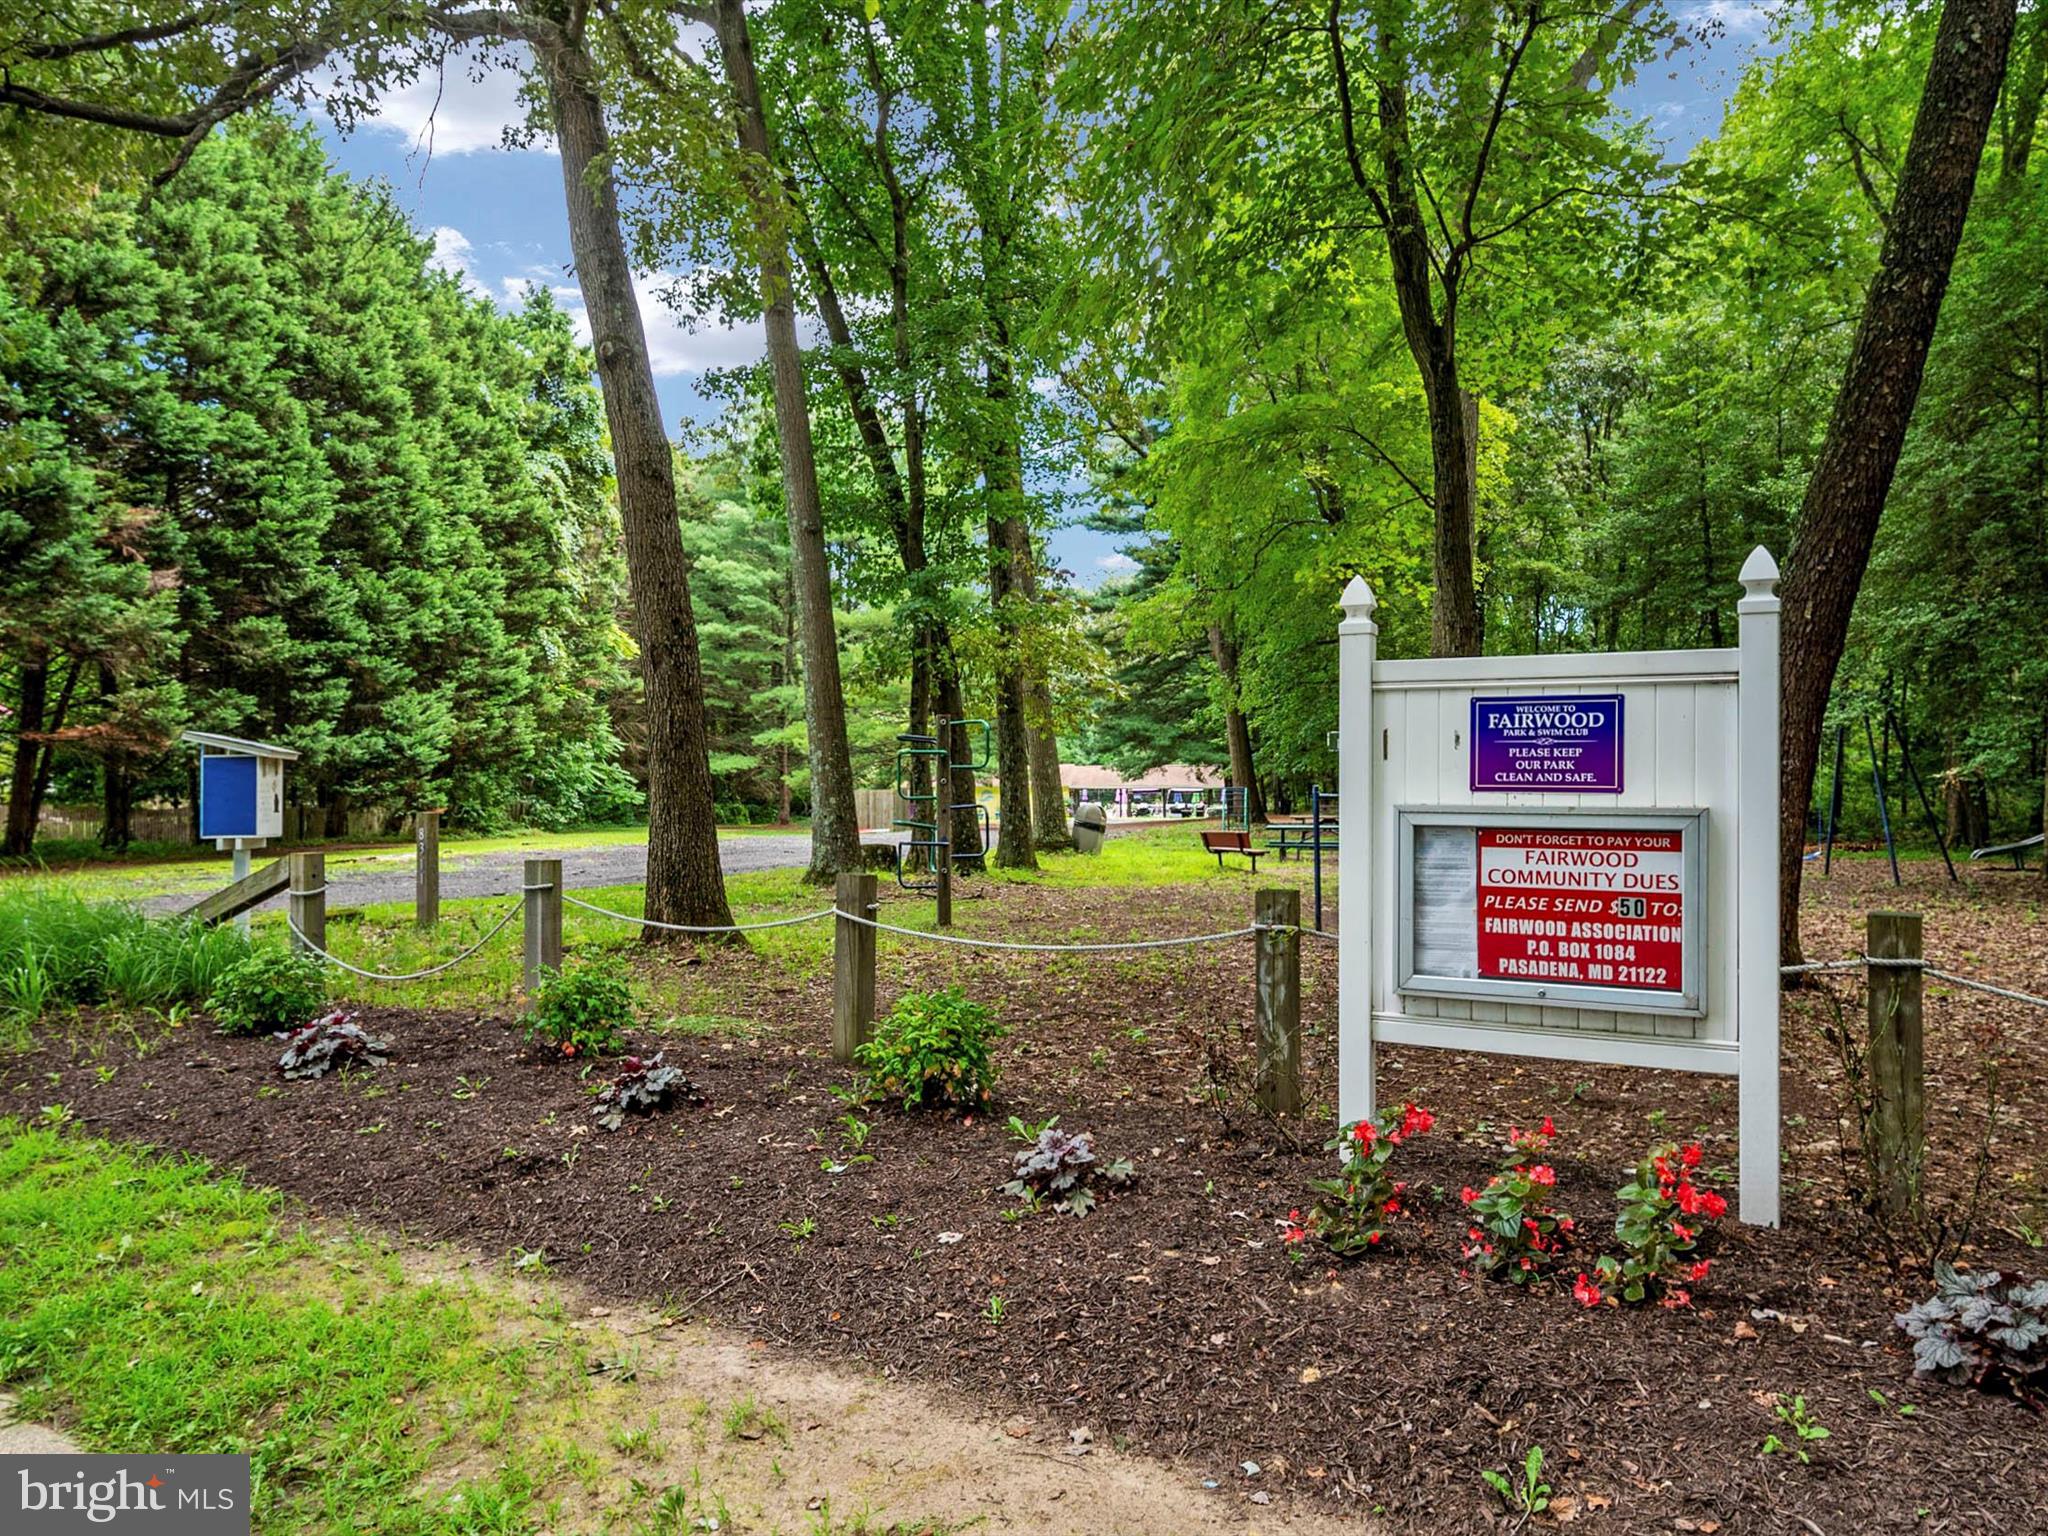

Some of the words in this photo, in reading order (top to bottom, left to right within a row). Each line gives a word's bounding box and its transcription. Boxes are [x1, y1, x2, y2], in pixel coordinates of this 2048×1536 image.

[1516, 705, 1561, 713] WELCOME
[1563, 704, 1576, 712] TO
[1488, 712, 1605, 729] FAIRWOOD
[1503, 729, 1527, 737] PARK
[1537, 728, 1563, 736] SWIM
[1564, 728, 1589, 736] CLUB
[1509, 748, 1551, 757] PLEASE
[1553, 748, 1583, 757] KEEP
[1515, 760, 1541, 770] OUR
[1543, 760, 1575, 769] PARK
[1495, 772, 1533, 782] CLEAN
[1536, 773, 1563, 782] AND
[1565, 773, 1597, 782] SAFE.
[1496, 834, 1534, 845] DON'T
[1536, 835, 1583, 846] FORGET
[1586, 836, 1604, 846] TO
[1607, 836, 1632, 847] PAY
[1635, 837, 1671, 848] YOUR
[1525, 850, 1639, 868] FAIRWOOD
[1488, 868, 1617, 888] COMMUNITY
[1623, 873, 1680, 891] DUES
[1484, 895, 1549, 911] PLEASE
[1553, 898, 1603, 913] SEND
[1651, 902, 1682, 917] TO:
[1485, 917, 1567, 937] FAIRWOOD
[1571, 922, 1681, 943] ASSOCIATION
[1527, 940, 1554, 957] P.O.
[1558, 942, 1591, 959] BOX
[1594, 944, 1636, 962] 1084
[1499, 958, 1584, 980] PASADENA,
[1588, 964, 1613, 981] MD
[1618, 966, 1667, 984] 21122
